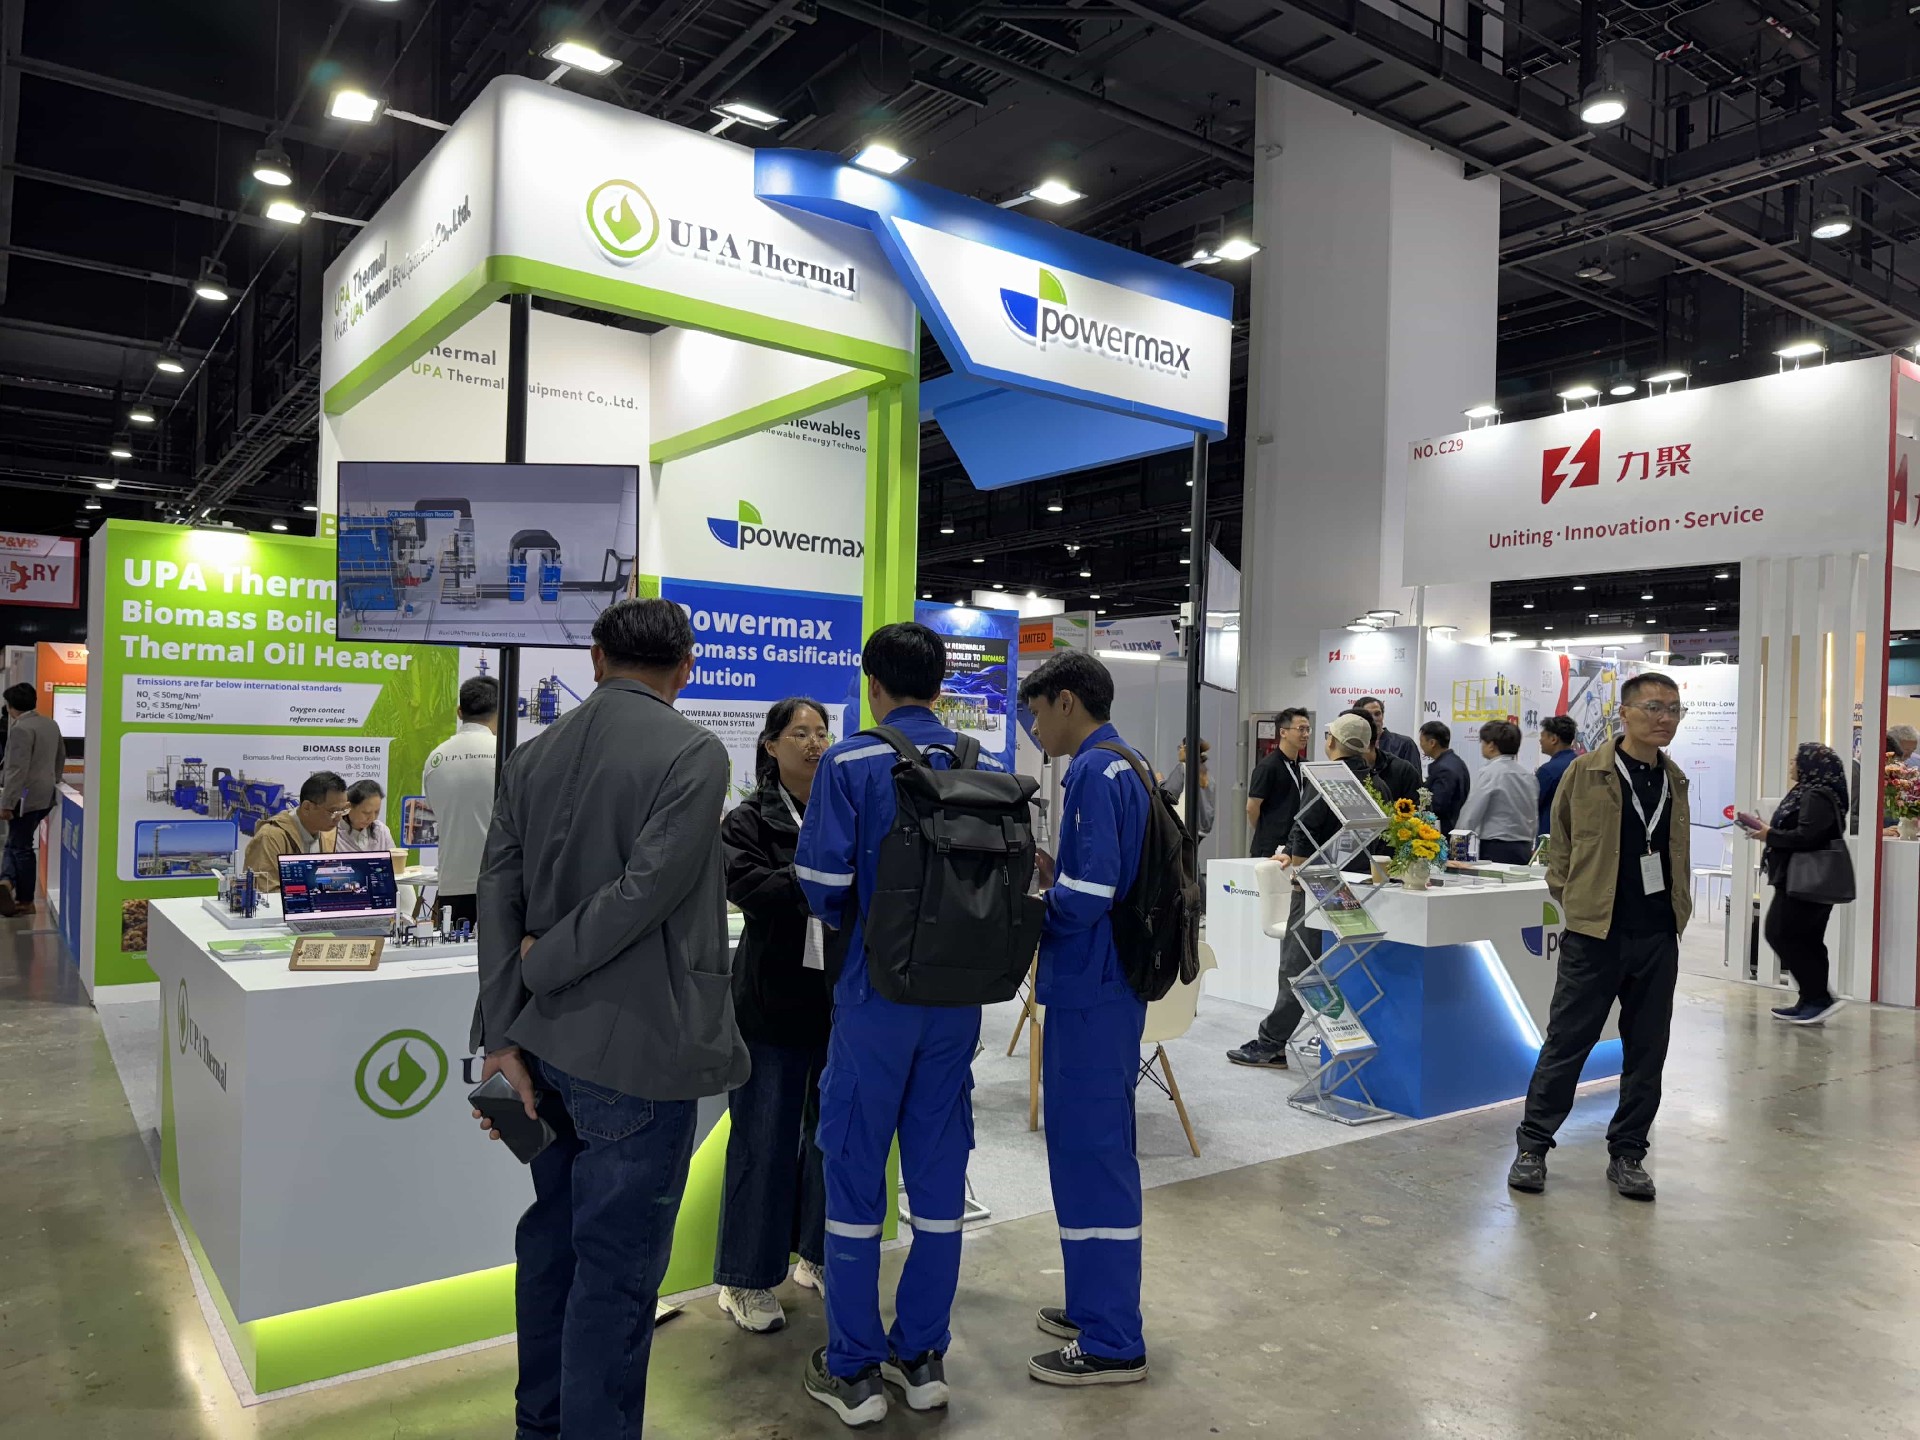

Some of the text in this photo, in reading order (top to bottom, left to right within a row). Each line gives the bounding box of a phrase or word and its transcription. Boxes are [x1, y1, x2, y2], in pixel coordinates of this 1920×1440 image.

[668, 218, 856, 293] UPA Thermal
[334, 240, 387, 317] UPA Thermal
[365, 269, 392, 312] Thermal
[1042, 306, 1191, 371] powermax
[429, 346, 496, 366] hermal
[411, 363, 443, 379] UPA
[447, 368, 505, 390] Thermal
[529, 382, 583, 401] uipment
[802, 434, 831, 447] Energy
[833, 440, 867, 453] Technolo
[1413, 438, 1464, 460] NO.C29
[1616, 443, 1692, 483] 力聚
[124, 558, 336, 600] UPA Therm
[122, 600, 336, 635] Biomass Boile
[1019, 632, 1047, 644] LIMITED
[120, 635, 413, 671] Thermal Oil Heater
[692, 642, 862, 667] omass Gasificatio
[137, 678, 182, 687] Emissions
[200, 680, 214, 688] far
[215, 681, 242, 689] below
[244, 682, 300, 691] international
[301, 684, 342, 692] standards
[686, 667, 756, 688] olution
[1349, 687, 1387, 695] Ultra-Low
[135, 711, 165, 720] Particle
[289, 715, 323, 724] reference
[290, 706, 317, 714] Oxygen
[681, 709, 721, 718] POWERMAX
[303, 745, 381, 753] BIOMASS BOILER
[1231, 888, 1260, 898] powerma
[203, 1035, 226, 1092] Thermal
